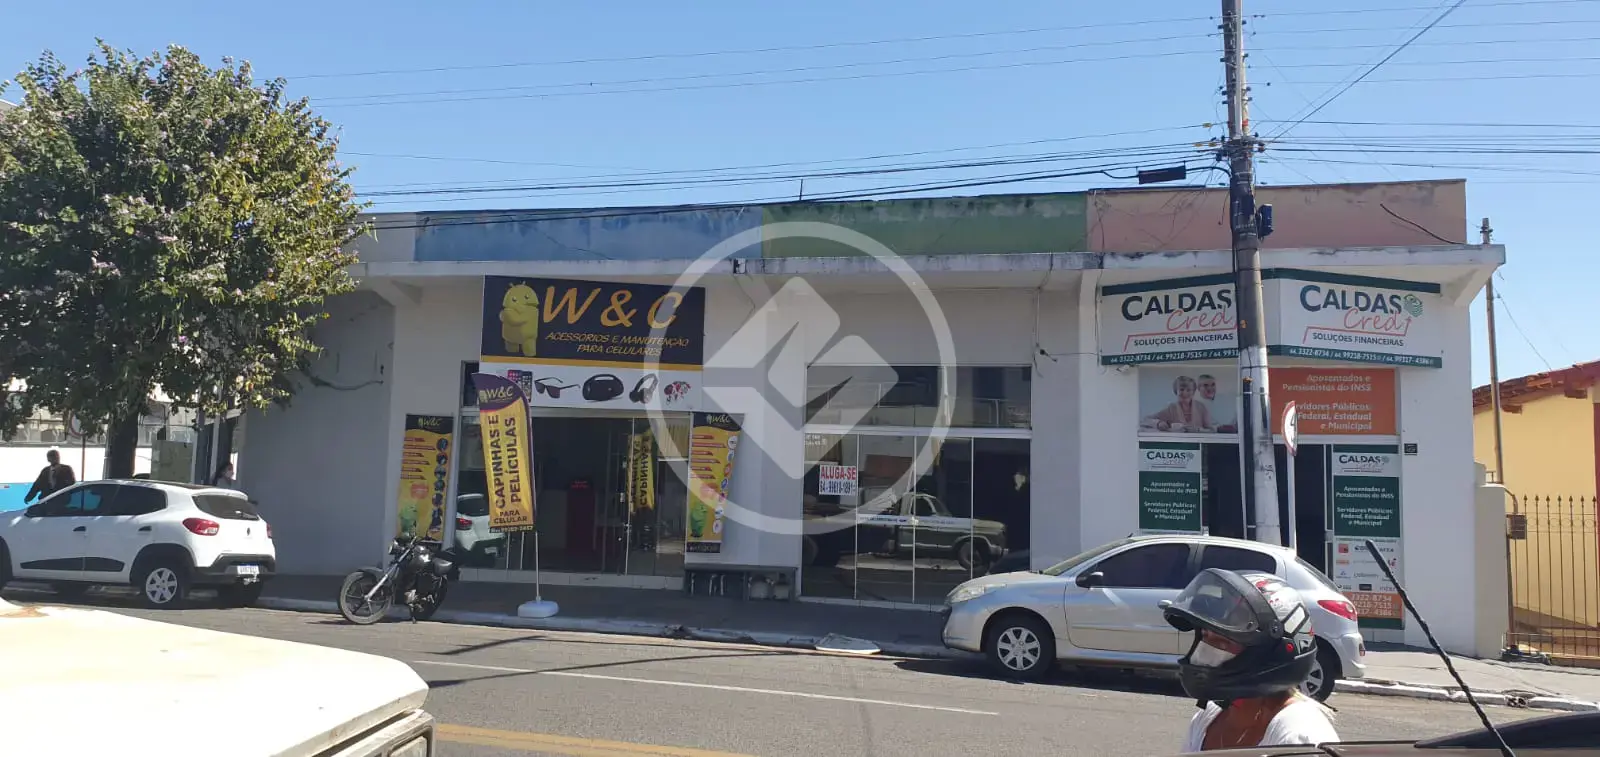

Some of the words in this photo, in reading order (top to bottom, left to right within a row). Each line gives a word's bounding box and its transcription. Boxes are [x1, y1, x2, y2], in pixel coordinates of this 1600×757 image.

[1121, 289, 1232, 321] CALDAS
[1300, 285, 1402, 314] CALDAS
[543, 286, 600, 324] W
[600, 290, 638, 327] &
[647, 292, 683, 329] C
[1166, 305, 1233, 331] Cred
[1343, 306, 1402, 331] Cred
[611, 335, 619, 343] E
[1134, 336, 1176, 347] SOLUÇÕES
[1178, 333, 1233, 343] FINANCEIRAS
[1312, 332, 1353, 343] SOLUÇÕES
[1354, 335, 1404, 346] FINANCEIRAS
[576, 344, 604, 353] PARA
[605, 345, 662, 356] CELULARES
[1307, 374, 1363, 383] Aposentados
[486, 386, 514, 400] W&C
[488, 415, 499, 425] E
[1334, 412, 1372, 420] Estadual
[1328, 422, 1372, 431] Municipal
[504, 417, 521, 504] PELÍCULAS
[1146, 451, 1186, 460] CALDAS
[1339, 455, 1381, 463] CALDAS
[490, 429, 506, 509] CAPINHAS
[821, 466, 856, 480] ALUGA-SE
[493, 515, 528, 525] CELULAR
[500, 509, 521, 517] PARA
